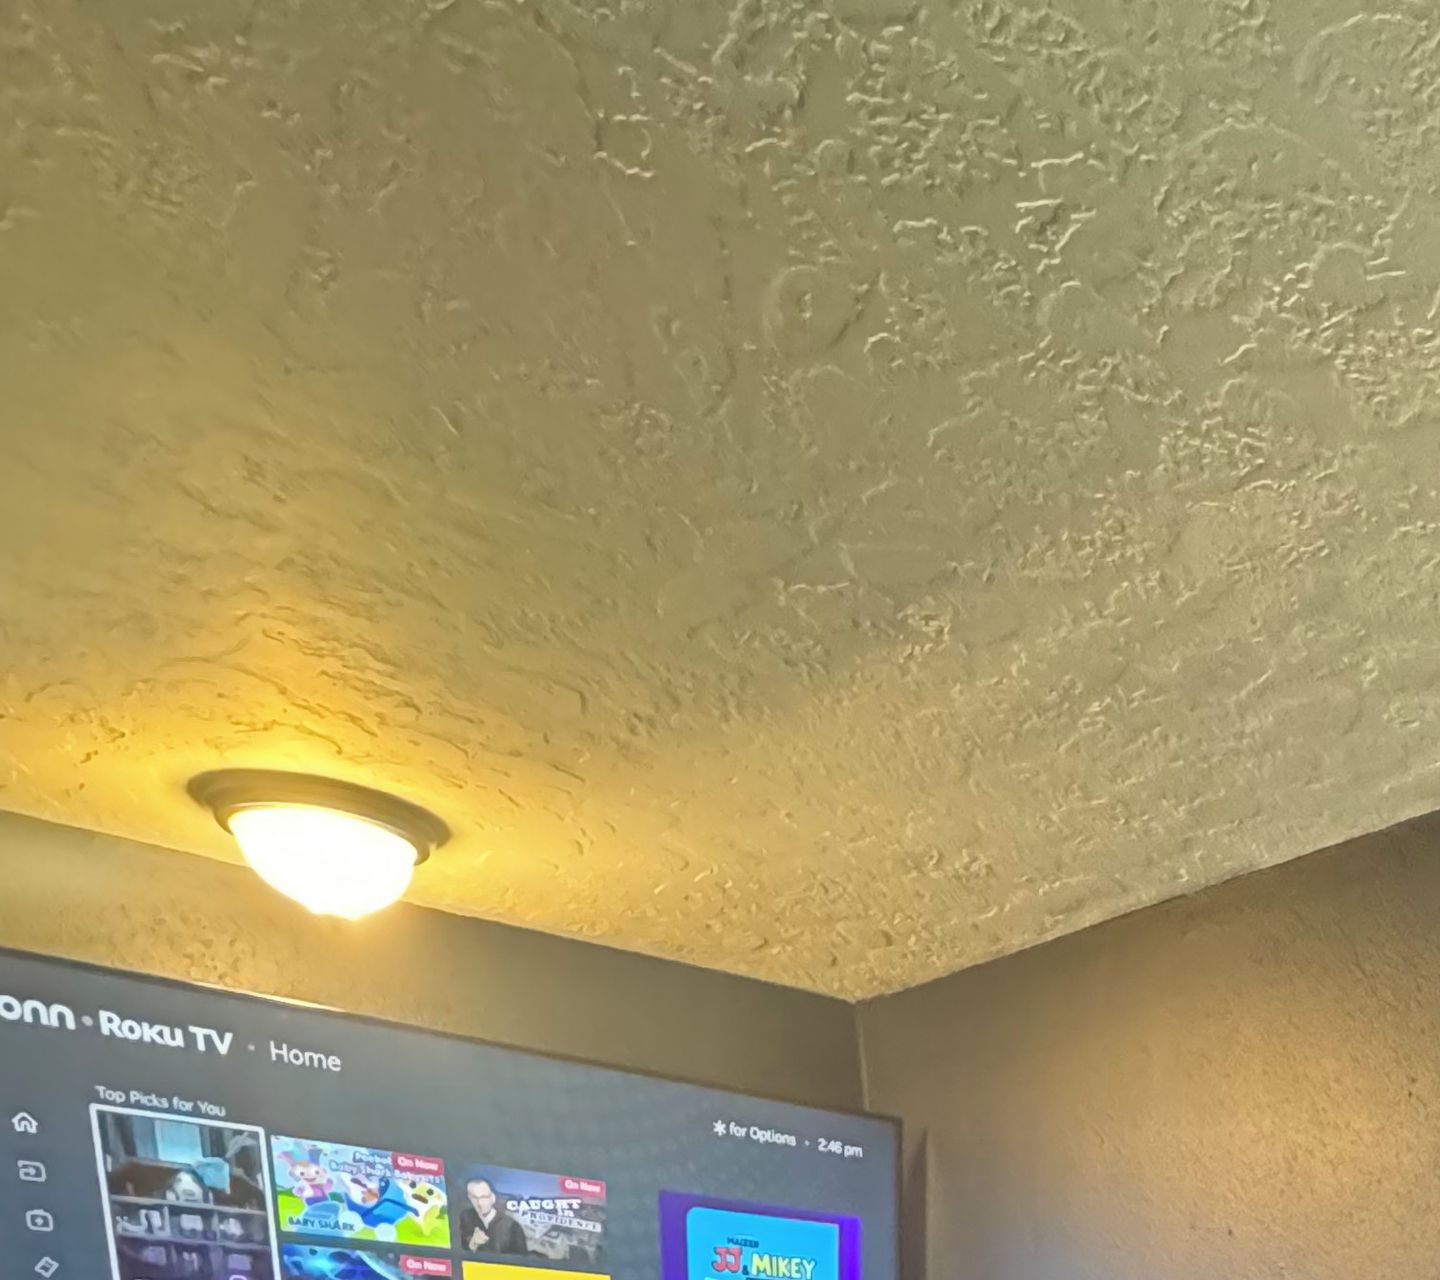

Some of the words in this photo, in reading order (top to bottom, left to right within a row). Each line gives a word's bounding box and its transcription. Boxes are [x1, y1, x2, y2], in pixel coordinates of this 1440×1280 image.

[0, 995, 76, 1031] onn
[98, 1009, 185, 1048] Roku
[188, 1026, 233, 1055] TV
[269, 1040, 342, 1072] Home
[94, 1085, 126, 1104] Top
[130, 1091, 169, 1110] Picks
[172, 1096, 194, 1113] for
[197, 1100, 226, 1117] You
[729, 1122, 747, 1137] for
[750, 1127, 797, 1146] Options
[844, 1145, 863, 1158] pm
[506, 1198, 582, 1211] CAUGHT
[751, 1252, 817, 1280] MIKEY
